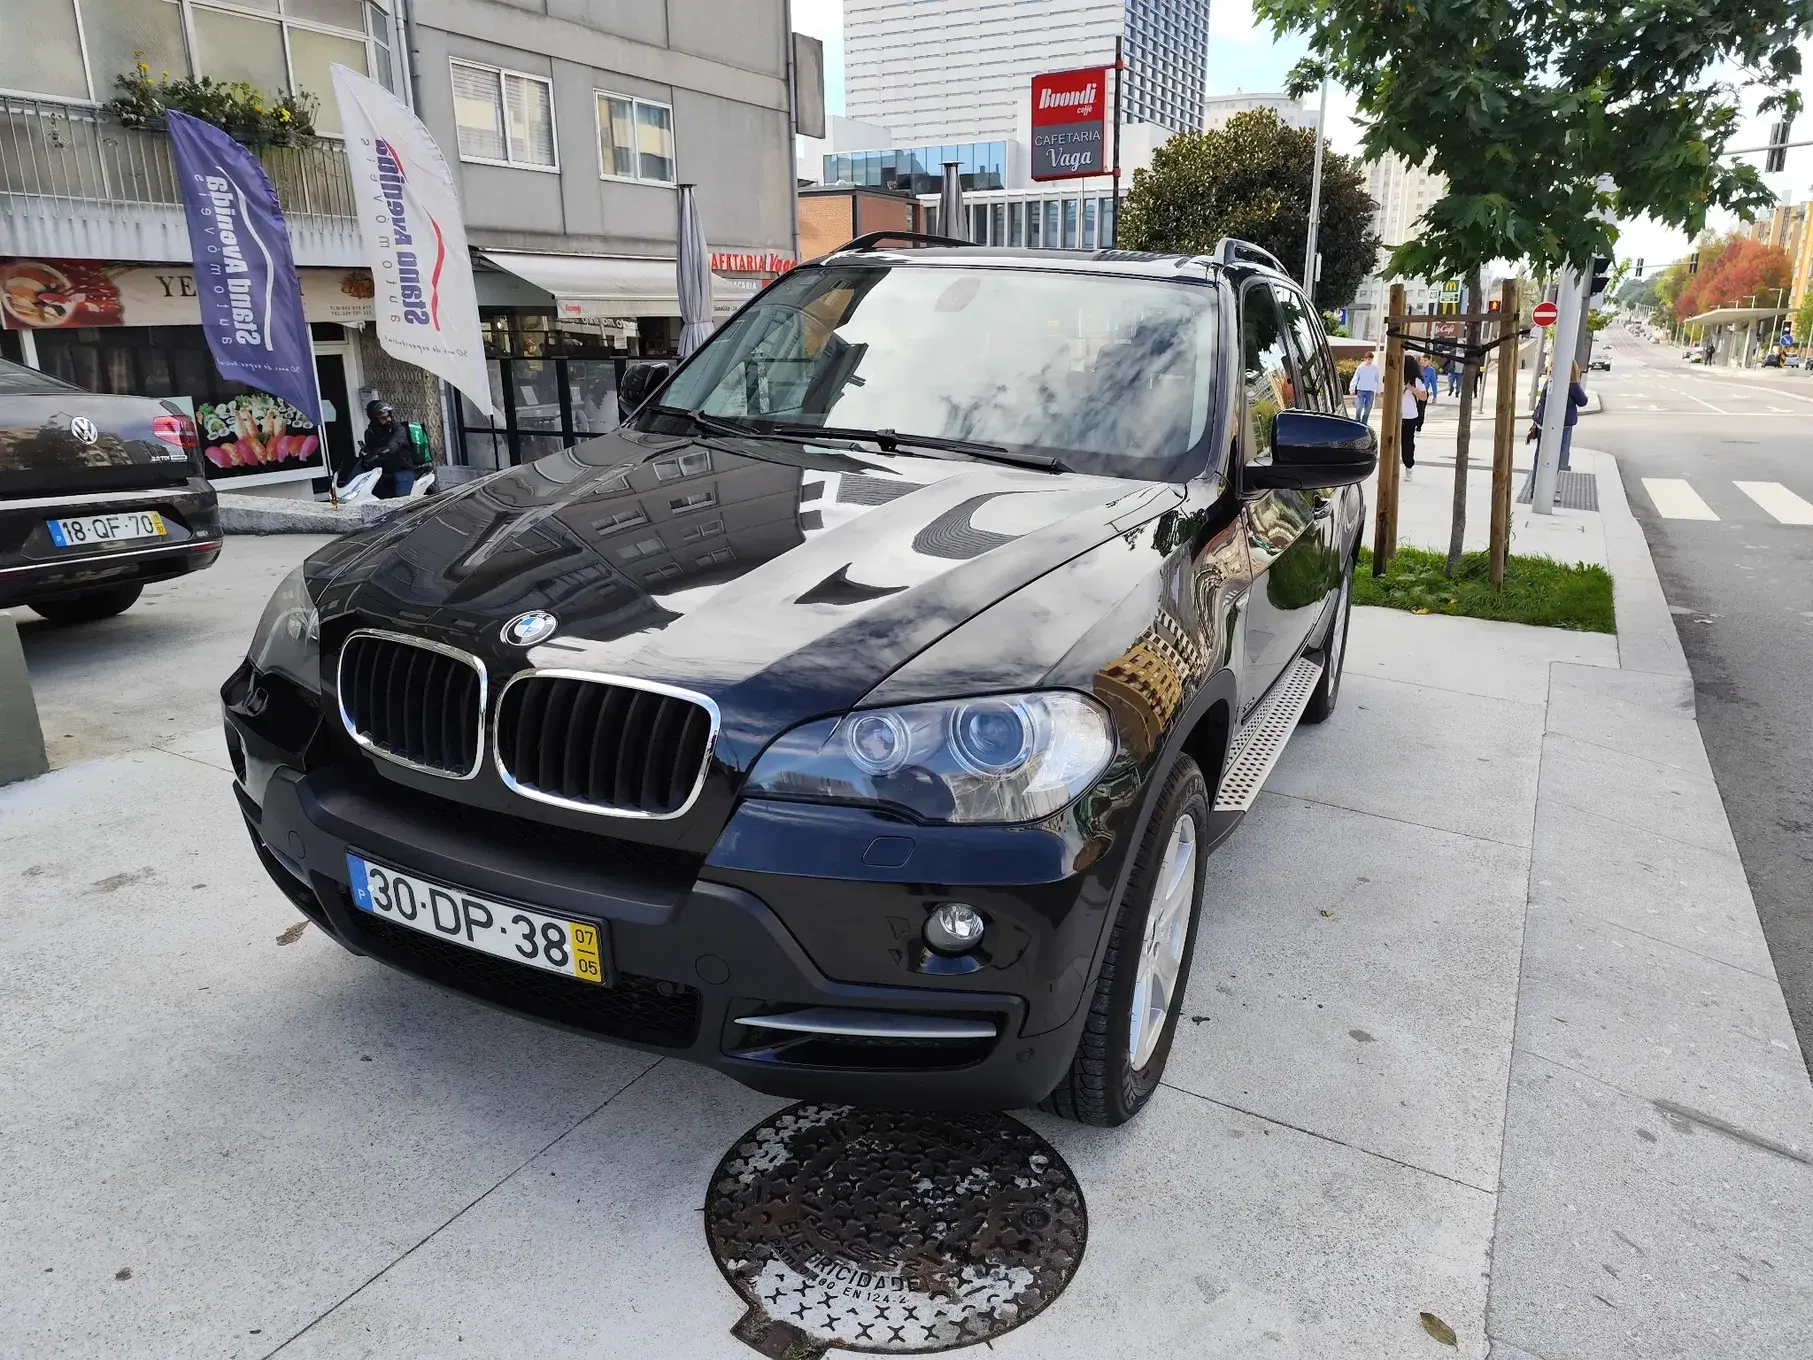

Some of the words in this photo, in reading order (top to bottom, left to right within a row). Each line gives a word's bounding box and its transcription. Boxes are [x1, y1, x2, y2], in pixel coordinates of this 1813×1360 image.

[1039, 83, 1097, 109] Buondi
[1035, 131, 1101, 146] CAFETARIA
[1046, 148, 1092, 172] Vaga
[357, 888, 366, 900] P
[574, 928, 594, 945] 07
[578, 957, 598, 976] 05
[842, 1287, 862, 1300] EN
